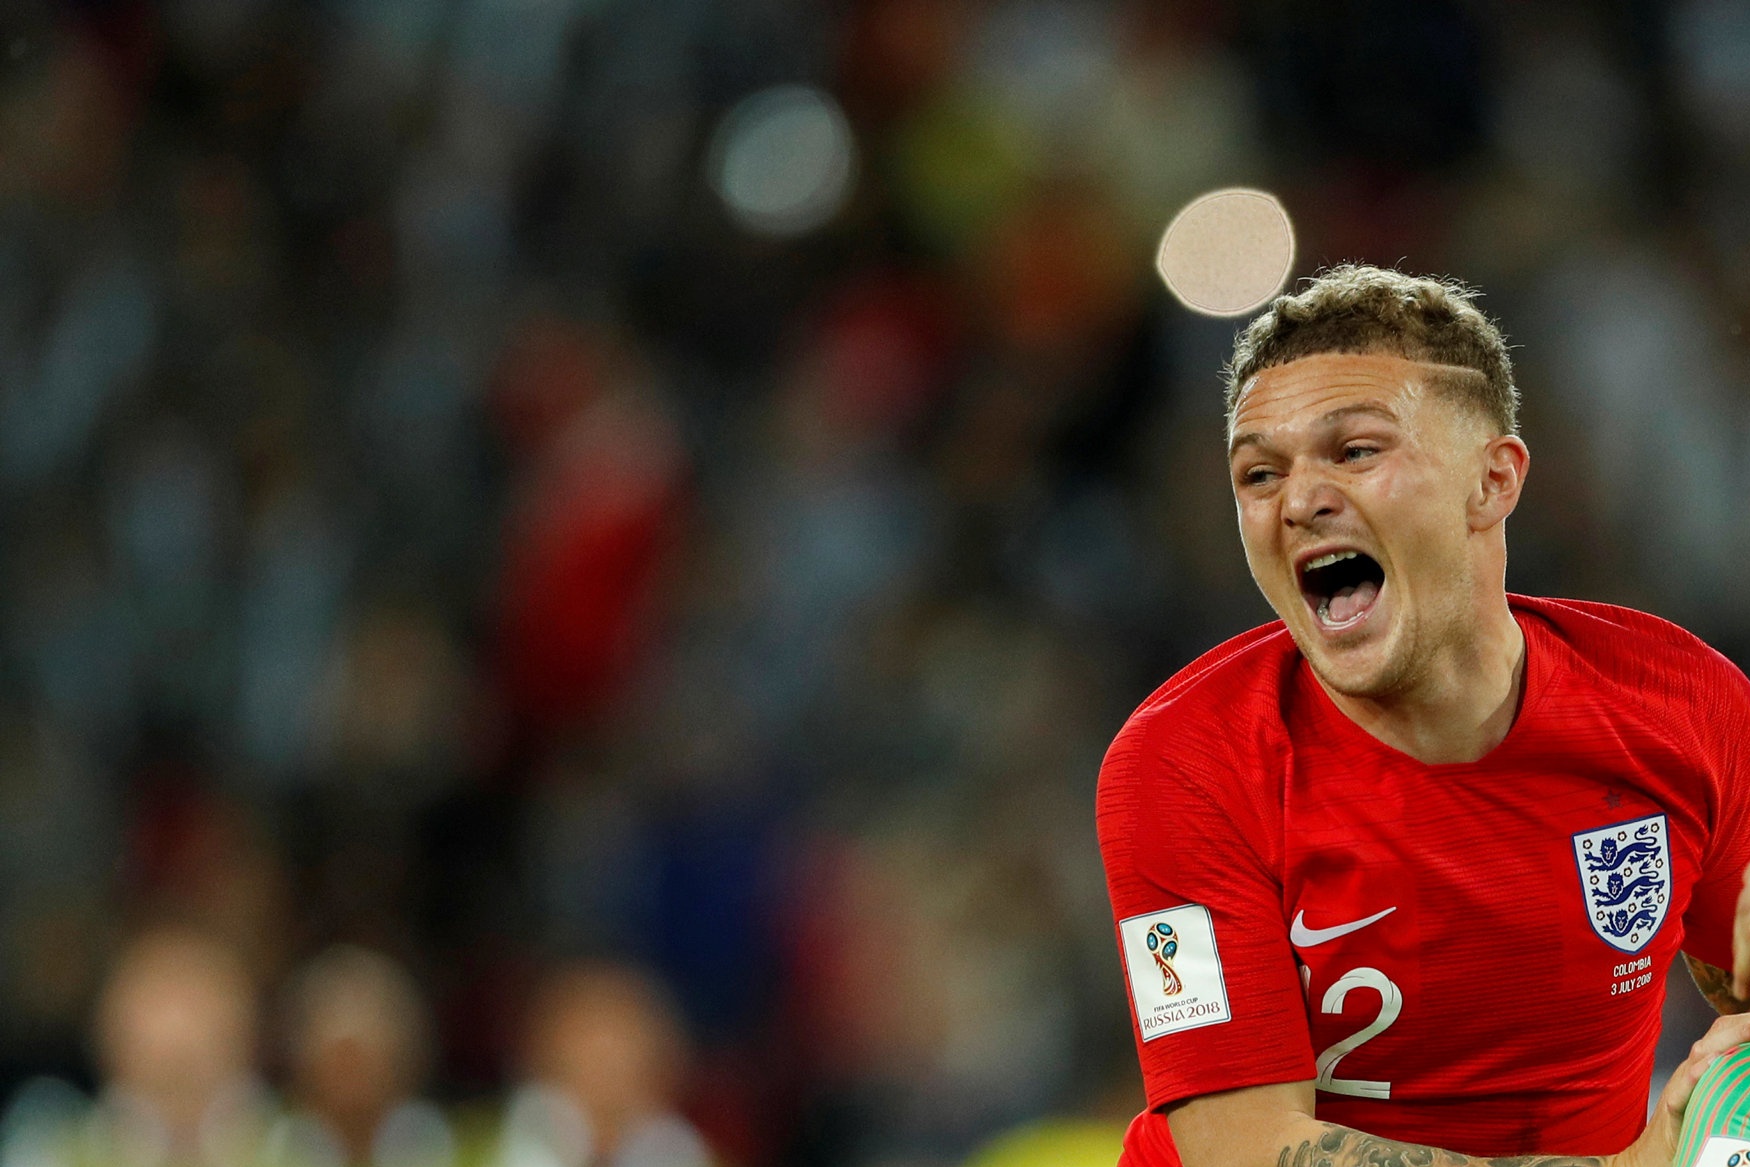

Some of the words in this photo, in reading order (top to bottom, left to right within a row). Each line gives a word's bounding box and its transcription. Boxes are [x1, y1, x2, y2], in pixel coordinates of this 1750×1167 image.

[1613, 955, 1652, 978] COLOMBIA
[1610, 983, 1618, 996] 3
[1618, 978, 1636, 994] JULY
[1636, 971, 1653, 989] 2018
[1143, 1010, 1186, 1031] RUSSIA
[1187, 1001, 1221, 1019] 2018
[1153, 1005, 1165, 1013] FIFA
[1165, 1000, 1186, 1011] WORLD
[1186, 997, 1199, 1006] CUP
[1299, 965, 1403, 1100] 2
